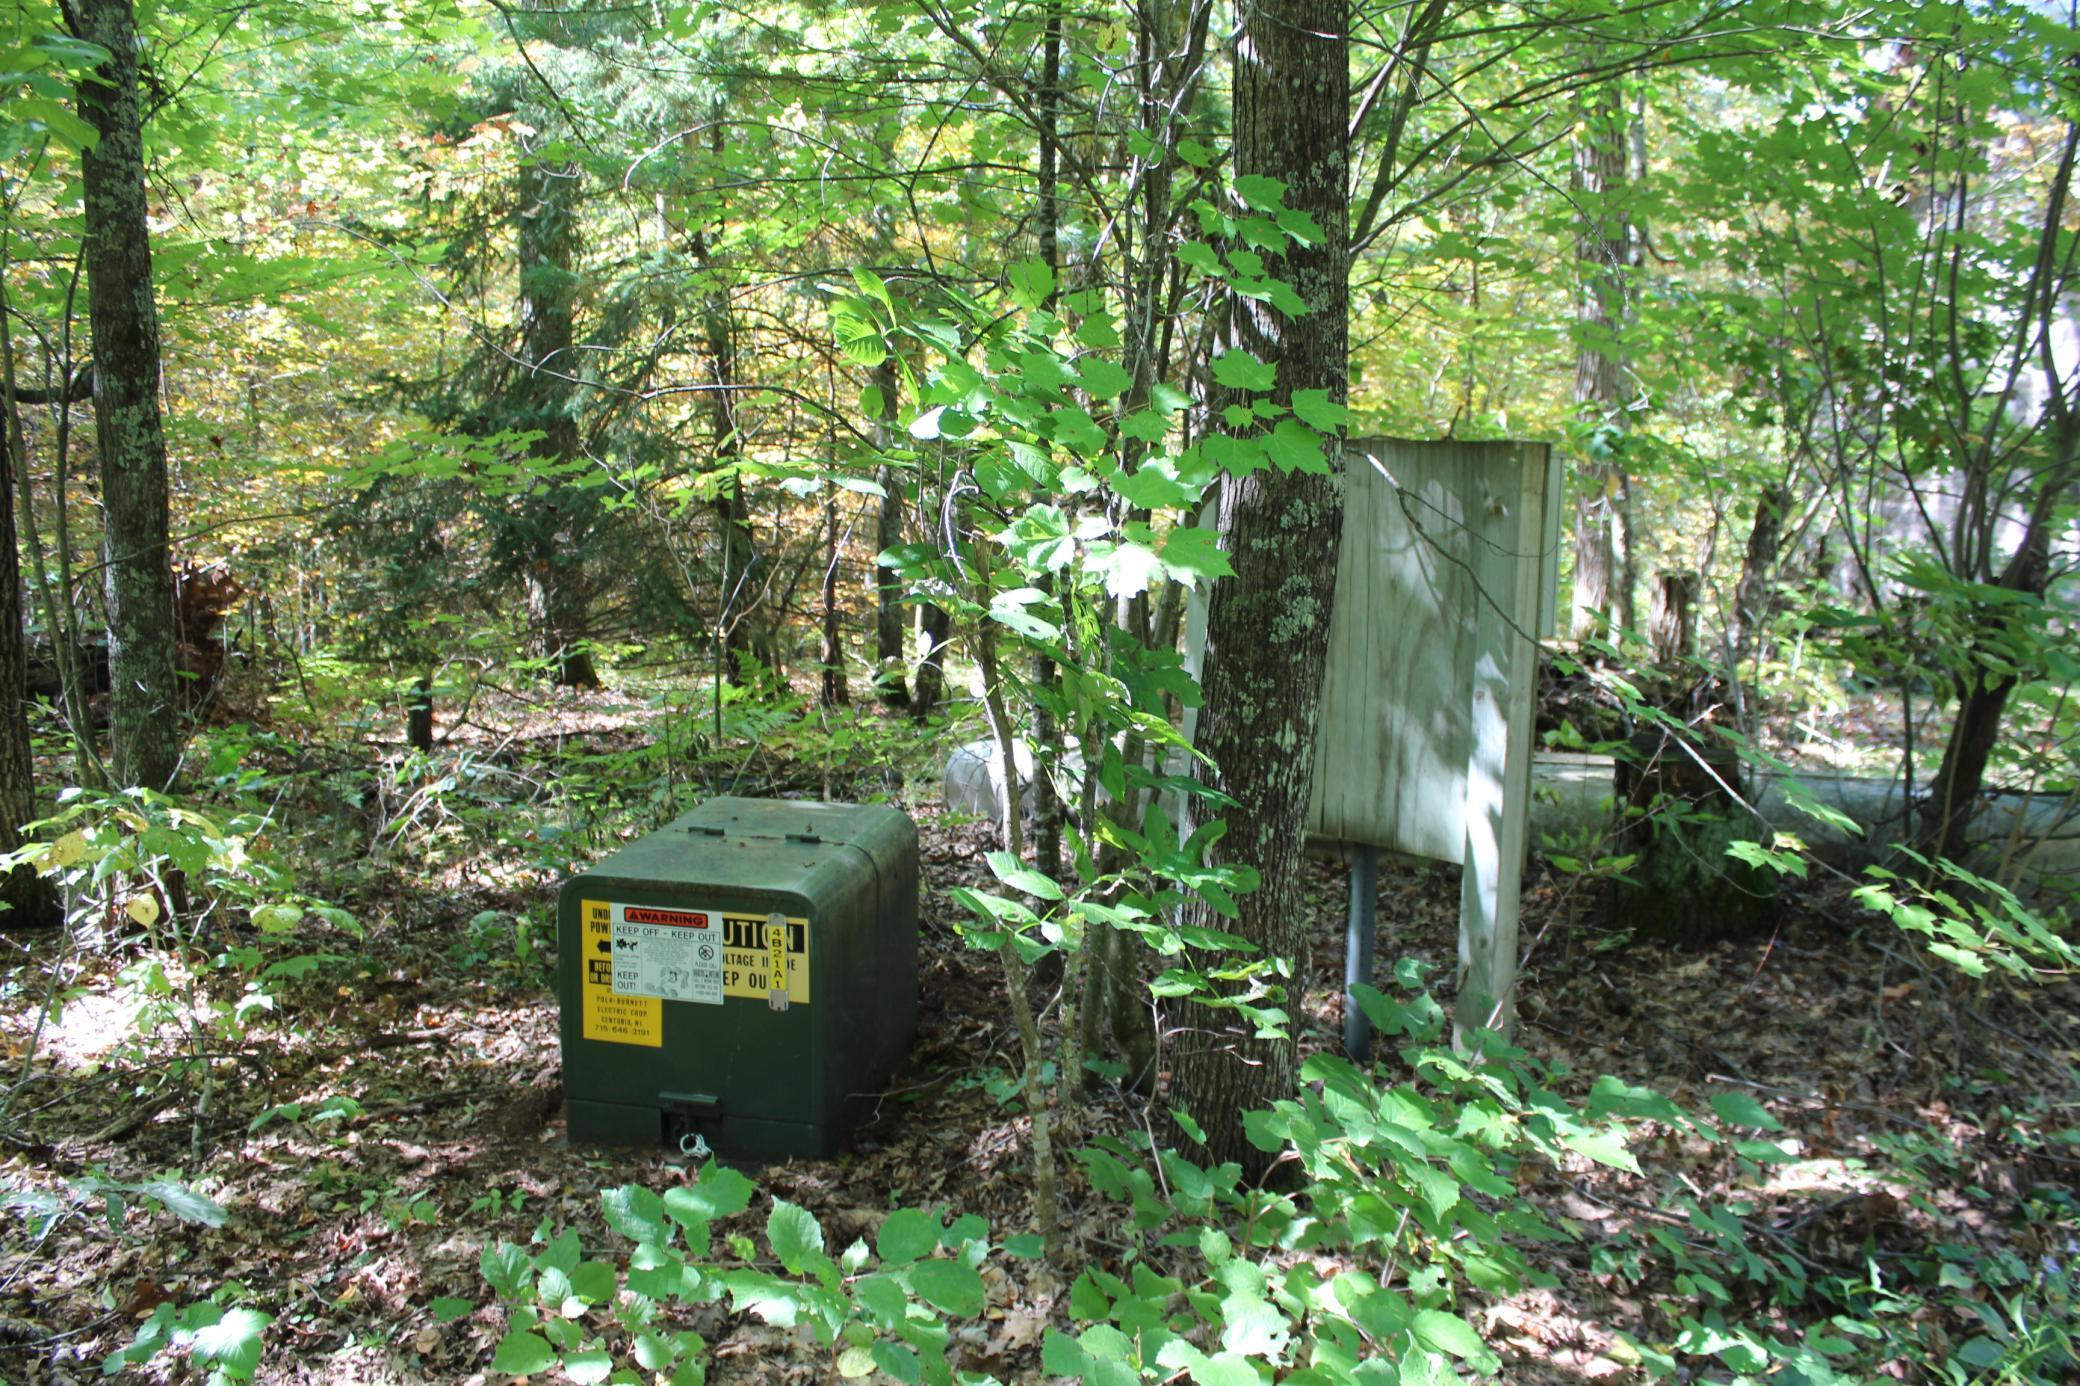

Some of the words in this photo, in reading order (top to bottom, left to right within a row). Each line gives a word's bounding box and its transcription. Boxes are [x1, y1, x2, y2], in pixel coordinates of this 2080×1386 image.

[639, 911, 704, 925] WARNING
[616, 926, 639, 935] KEEP
[643, 928, 660, 936] OFF
[671, 931, 695, 940] KEEP
[698, 932, 716, 941] OUT
[617, 971, 639, 981] KEEP
[617, 981, 637, 991] OUT!
[596, 1006, 627, 1016] ELECTRIC
[630, 1009, 648, 1017] COOP
